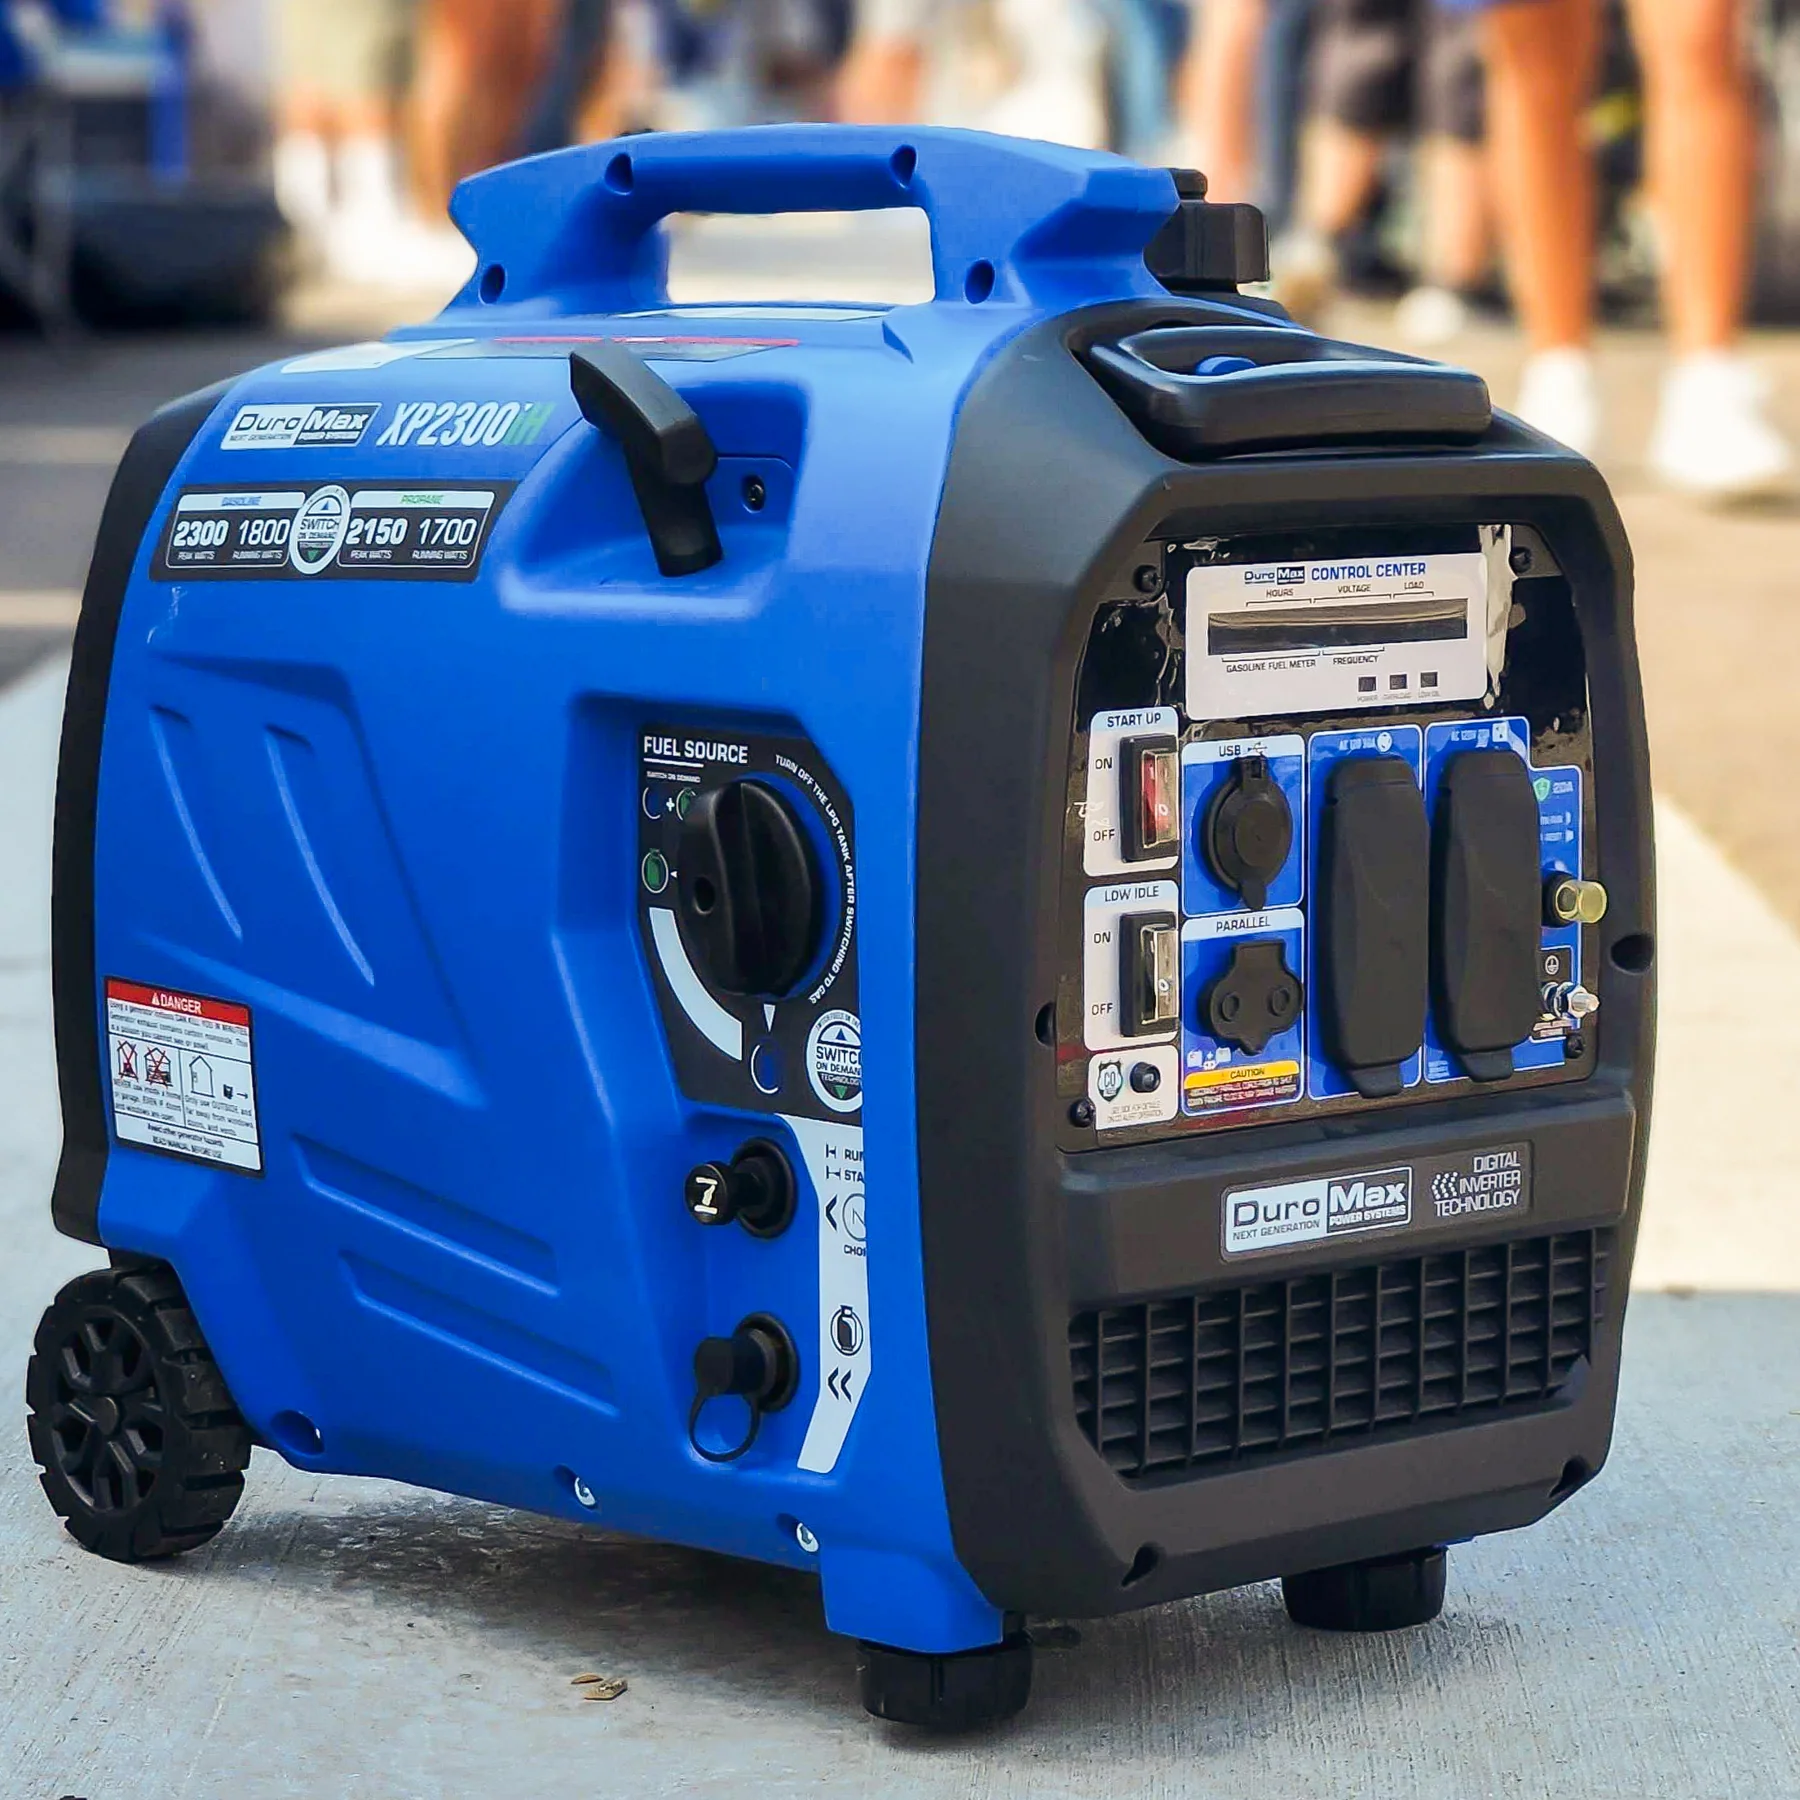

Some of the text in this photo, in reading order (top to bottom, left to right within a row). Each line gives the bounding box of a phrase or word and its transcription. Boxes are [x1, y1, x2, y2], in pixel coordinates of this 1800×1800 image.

[173, 519, 290, 547] 2300 1800
[346, 518, 477, 545] 2150 1700
[1311, 565, 1372, 581] CONTROL
[1376, 562, 1426, 577] CENTER
[1266, 588, 1294, 598] HOURS
[1337, 584, 1371, 593] VOLTAGE
[1404, 581, 1424, 590] LOAD
[1226, 659, 1316, 673] GASOLINE FUEL METER
[1332, 655, 1379, 665] FREQUENCY
[1107, 712, 1161, 727] START UP
[643, 735, 748, 763] FUEL SOURCE
[1219, 744, 1241, 757] USB
[775, 754, 798, 773] TURN
[1095, 758, 1113, 769] ON
[798, 768, 814, 786] OFF
[812, 782, 828, 806] THE
[1093, 829, 1115, 842] OFF
[836, 826, 851, 862] TANK
[845, 864, 855, 904] AFTER
[1104, 886, 1159, 902] LOW IDLE
[1216, 916, 1270, 932] PARALLEL
[832, 907, 854, 974] SWITCHING
[1094, 931, 1111, 943] ON
[824, 973, 836, 988] TO
[808, 984, 826, 1004] GAS
[160, 993, 202, 1014] DANGER
[1092, 1003, 1113, 1015] OFF
[816, 1062, 828, 1071] ON
[1230, 1066, 1265, 1079] CAUTION
[821, 1073, 861, 1085] TECHNOLOG
[1104, 1071, 1116, 1087] CO
[1473, 1151, 1520, 1172] DIGITAL
[1460, 1170, 1520, 1194] INVERTER
[1434, 1189, 1520, 1216] TECHNOLOGY
[1329, 1205, 1406, 1227] POWER SYSTEMS
[1233, 1219, 1320, 1240] NEXT GENERATION
